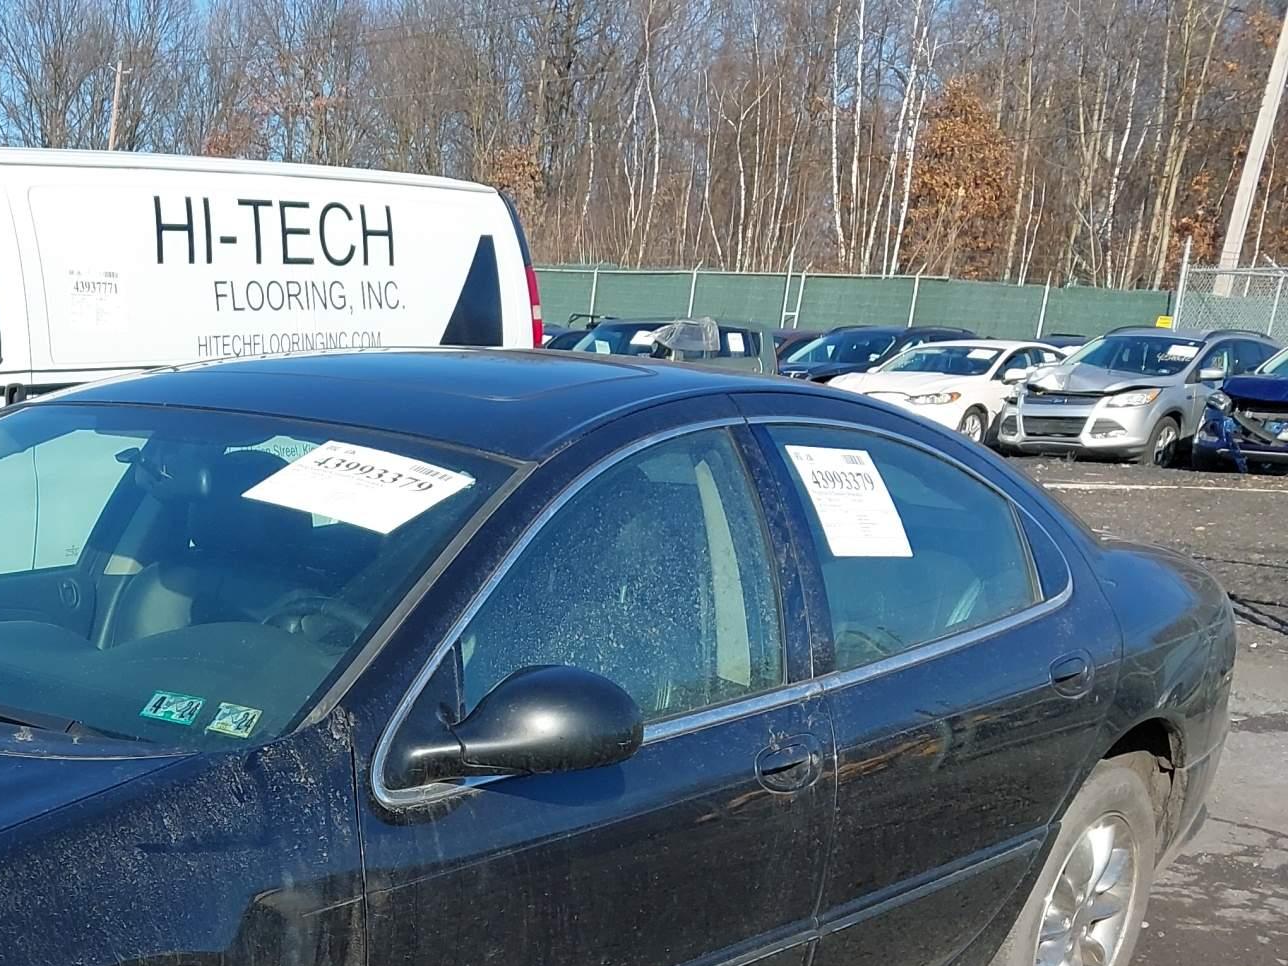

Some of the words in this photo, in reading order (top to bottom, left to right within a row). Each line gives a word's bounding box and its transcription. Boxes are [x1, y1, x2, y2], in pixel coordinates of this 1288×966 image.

[153, 195, 395, 267] HI-TECH
[214, 280, 354, 315] FLOORING,
[361, 280, 406, 311] INC.
[197, 330, 383, 358] HITECHFLOORINGINCCOM
[313, 456, 434, 492] 43993379
[811, 470, 875, 491] 43993379
